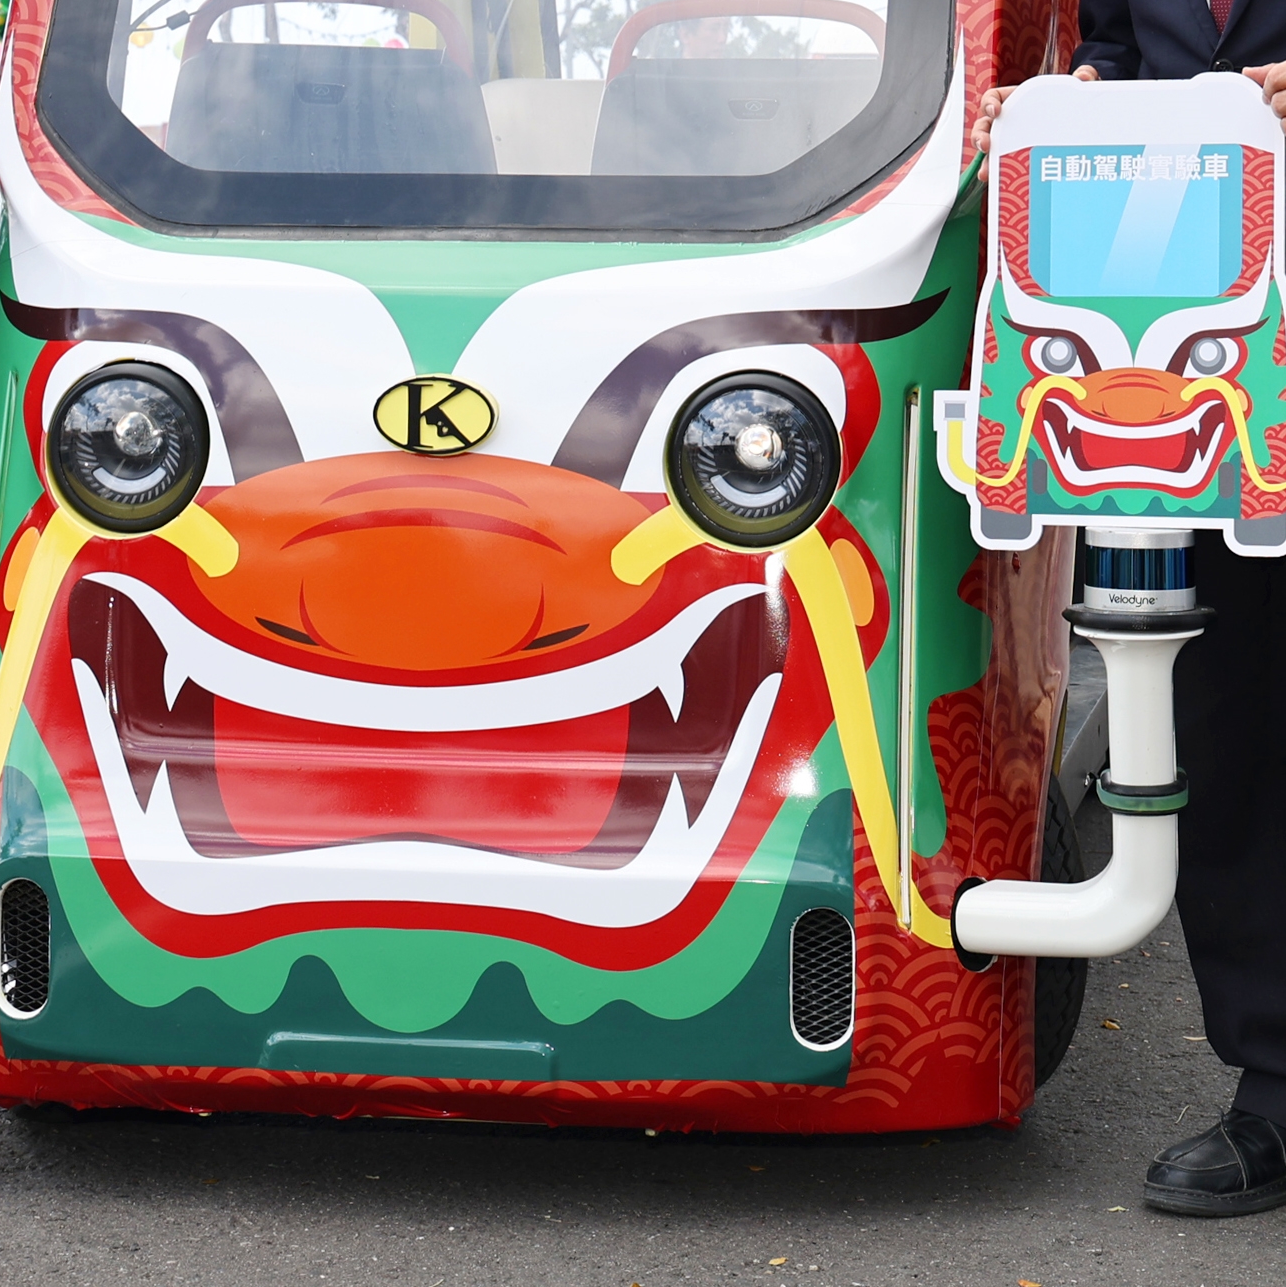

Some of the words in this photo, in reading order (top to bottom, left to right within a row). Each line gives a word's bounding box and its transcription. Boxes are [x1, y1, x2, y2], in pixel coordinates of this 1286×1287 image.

[1040, 153, 1229, 183] 自動駕駛實驗車
[395, 380, 477, 452] K
[1108, 593, 1156, 608] Velodyne
